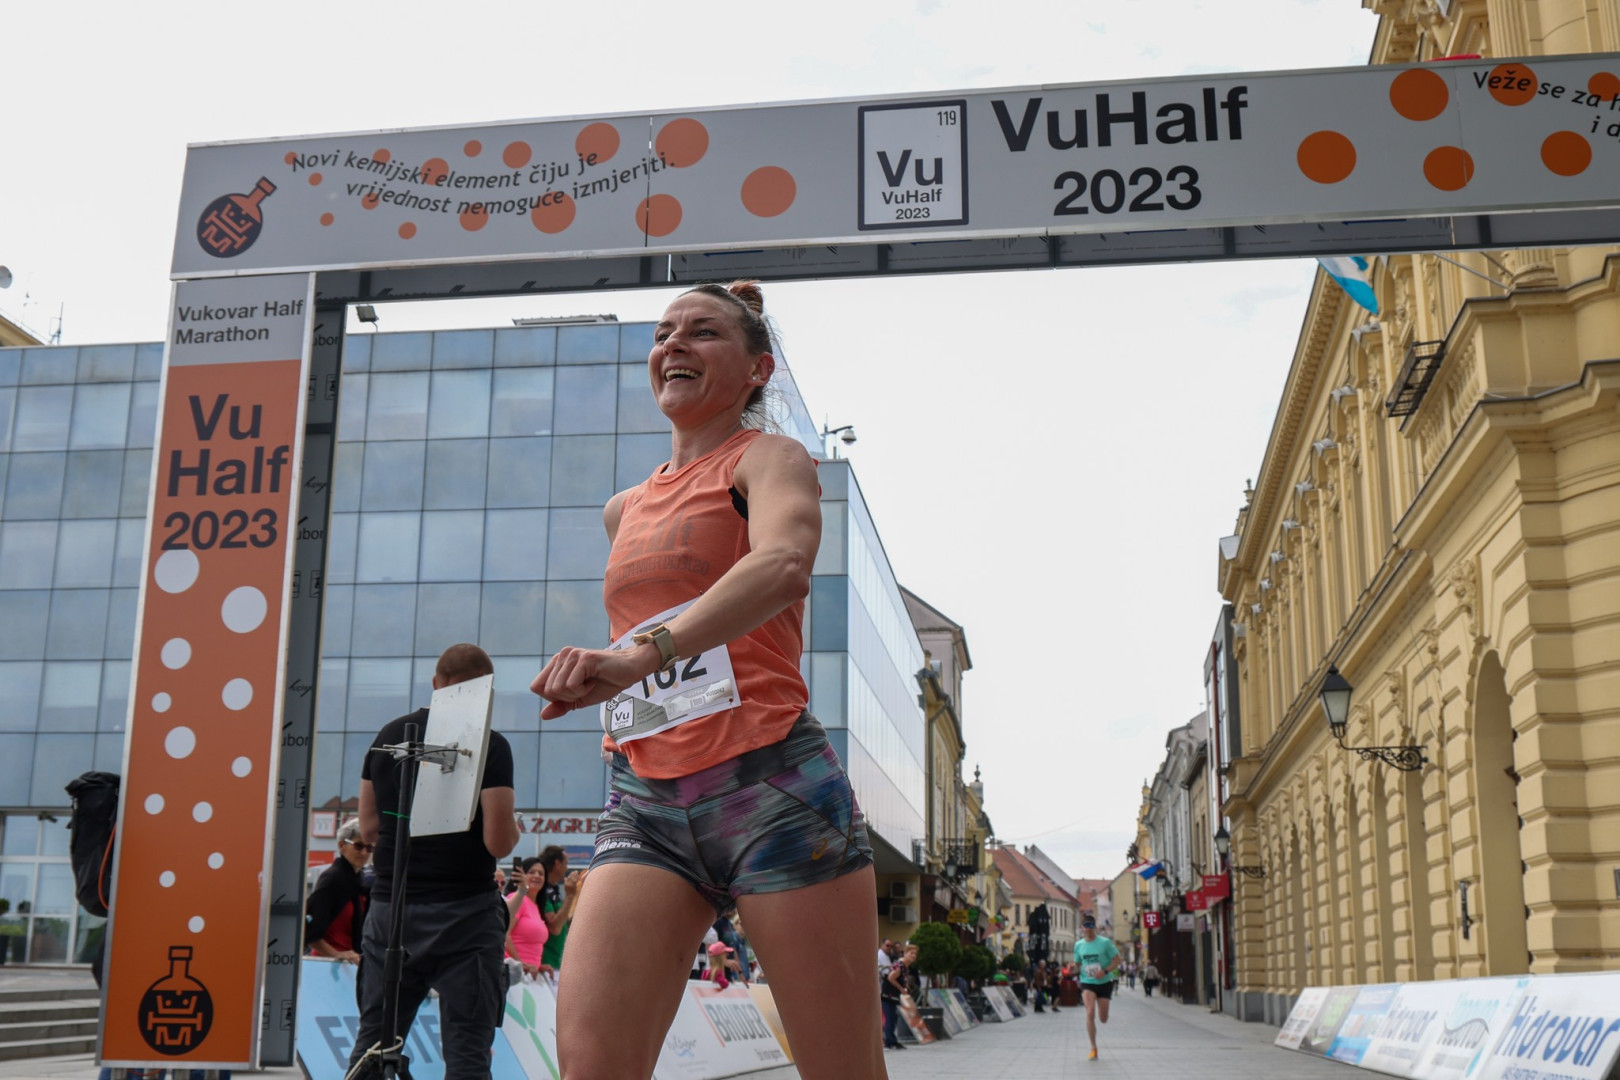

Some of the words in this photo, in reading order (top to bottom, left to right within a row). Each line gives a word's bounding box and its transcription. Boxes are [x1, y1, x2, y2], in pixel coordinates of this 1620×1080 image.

[1473, 70, 1531, 91] Veže
[1537, 81, 1566, 99] se
[1571, 90, 1602, 107] za
[937, 110, 957, 126] 119
[990, 86, 1249, 153] VuHalf
[1591, 115, 1601, 133] i
[292, 149, 340, 172] Novi
[344, 151, 432, 185] kemijski
[435, 170, 522, 189] element
[529, 161, 570, 185] čiju
[577, 152, 598, 176] je
[346, 181, 452, 213] vrijednost
[456, 188, 565, 216] nemoguće
[573, 152, 675, 200] izmjeriti.
[876, 149, 943, 188] Vu
[882, 188, 943, 205] VuHalf
[1053, 165, 1202, 216] 2023
[895, 207, 931, 220] 2023
[177, 303, 258, 322] Vukovar
[263, 299, 304, 317] Half
[175, 326, 270, 345] Marathon
[188, 393, 263, 441] Vu
[167, 445, 290, 497] Half
[160, 507, 278, 551] 2023
[615, 711, 630, 721] Vu
[531, 816, 600, 834] ZAGRE
